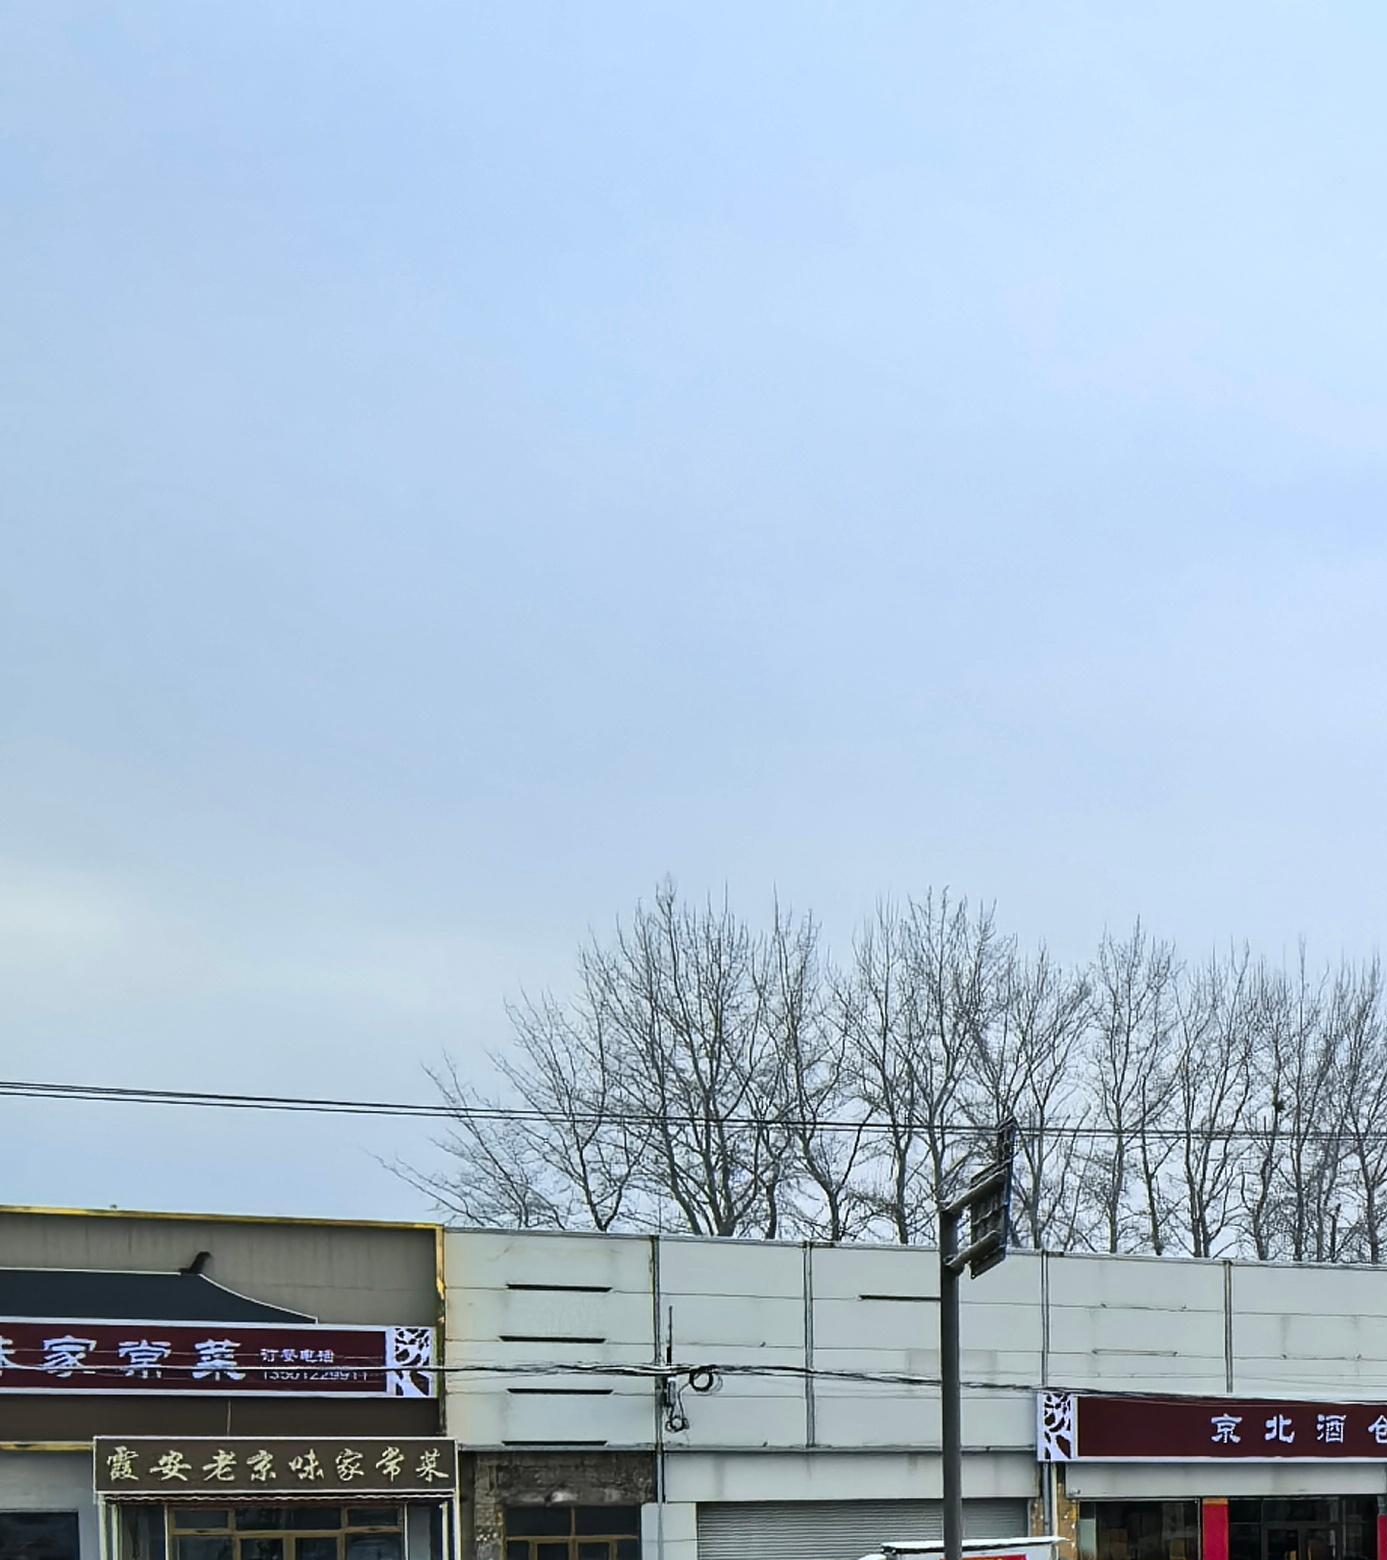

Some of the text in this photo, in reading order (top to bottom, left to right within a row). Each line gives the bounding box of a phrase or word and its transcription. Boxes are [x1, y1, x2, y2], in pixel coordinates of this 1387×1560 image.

[105, 1445, 450, 1482] 霞安老京味家常菜
